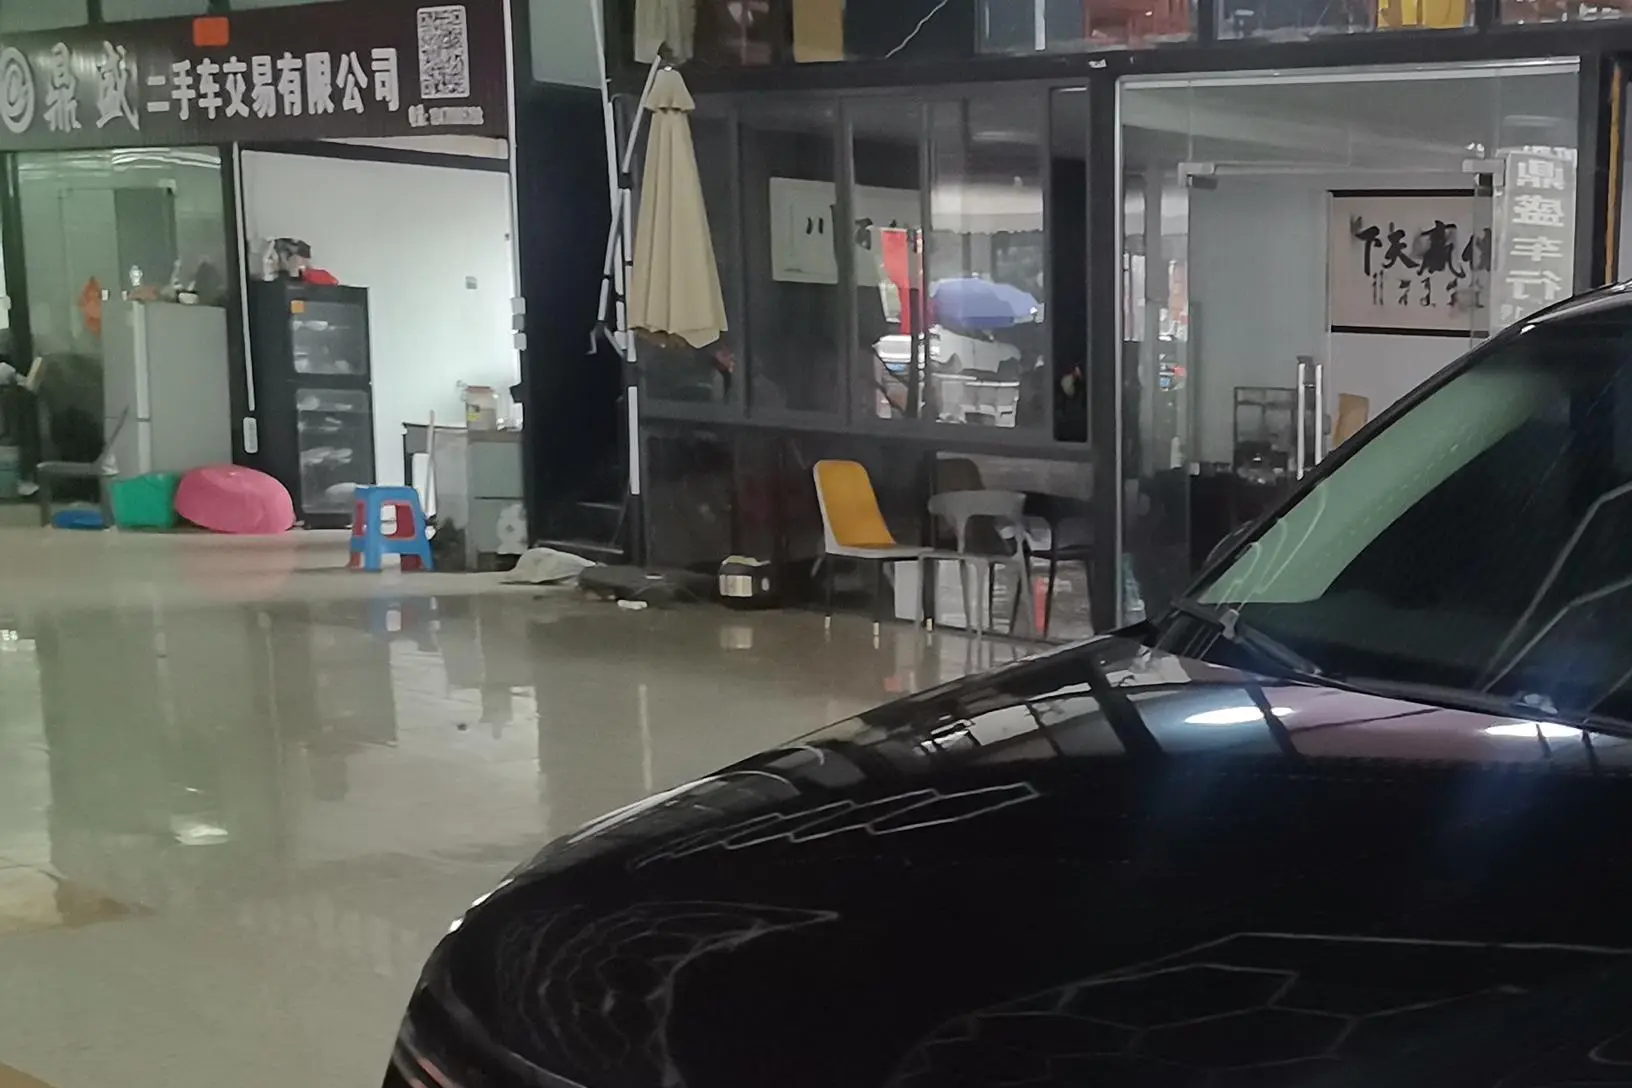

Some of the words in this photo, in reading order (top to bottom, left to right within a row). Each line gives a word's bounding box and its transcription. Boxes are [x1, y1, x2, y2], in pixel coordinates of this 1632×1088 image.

[146, 48, 399, 121] 二手车交易有限公司
